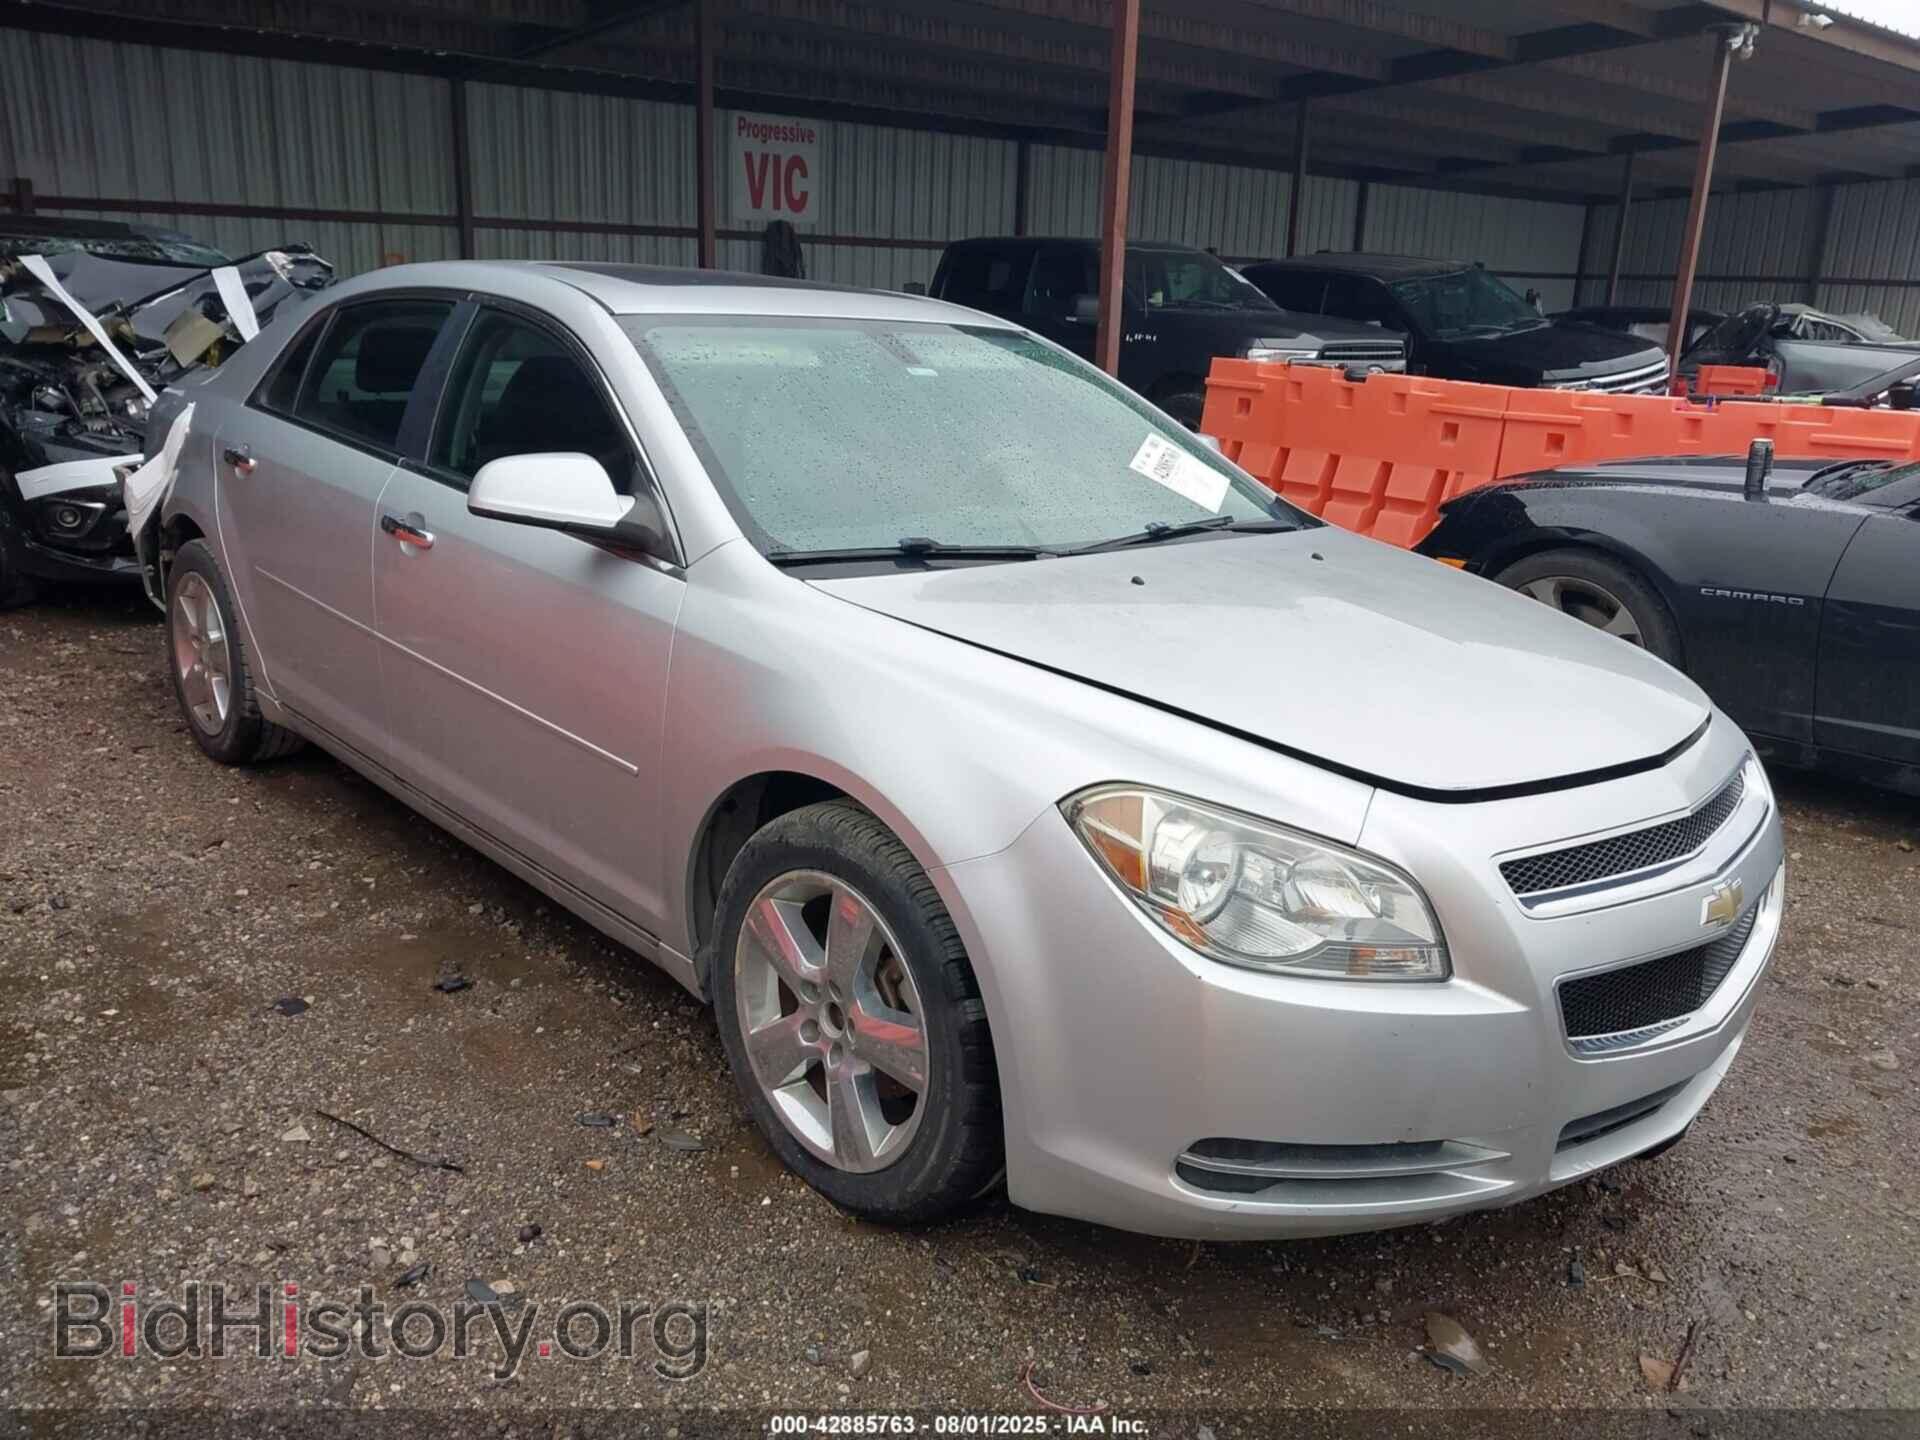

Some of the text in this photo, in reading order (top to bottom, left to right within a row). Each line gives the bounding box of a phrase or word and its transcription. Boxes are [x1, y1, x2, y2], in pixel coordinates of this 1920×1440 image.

[737, 116, 816, 143] Progressive
[744, 151, 809, 213] VIC
[1700, 587, 1805, 606] CAMARO
